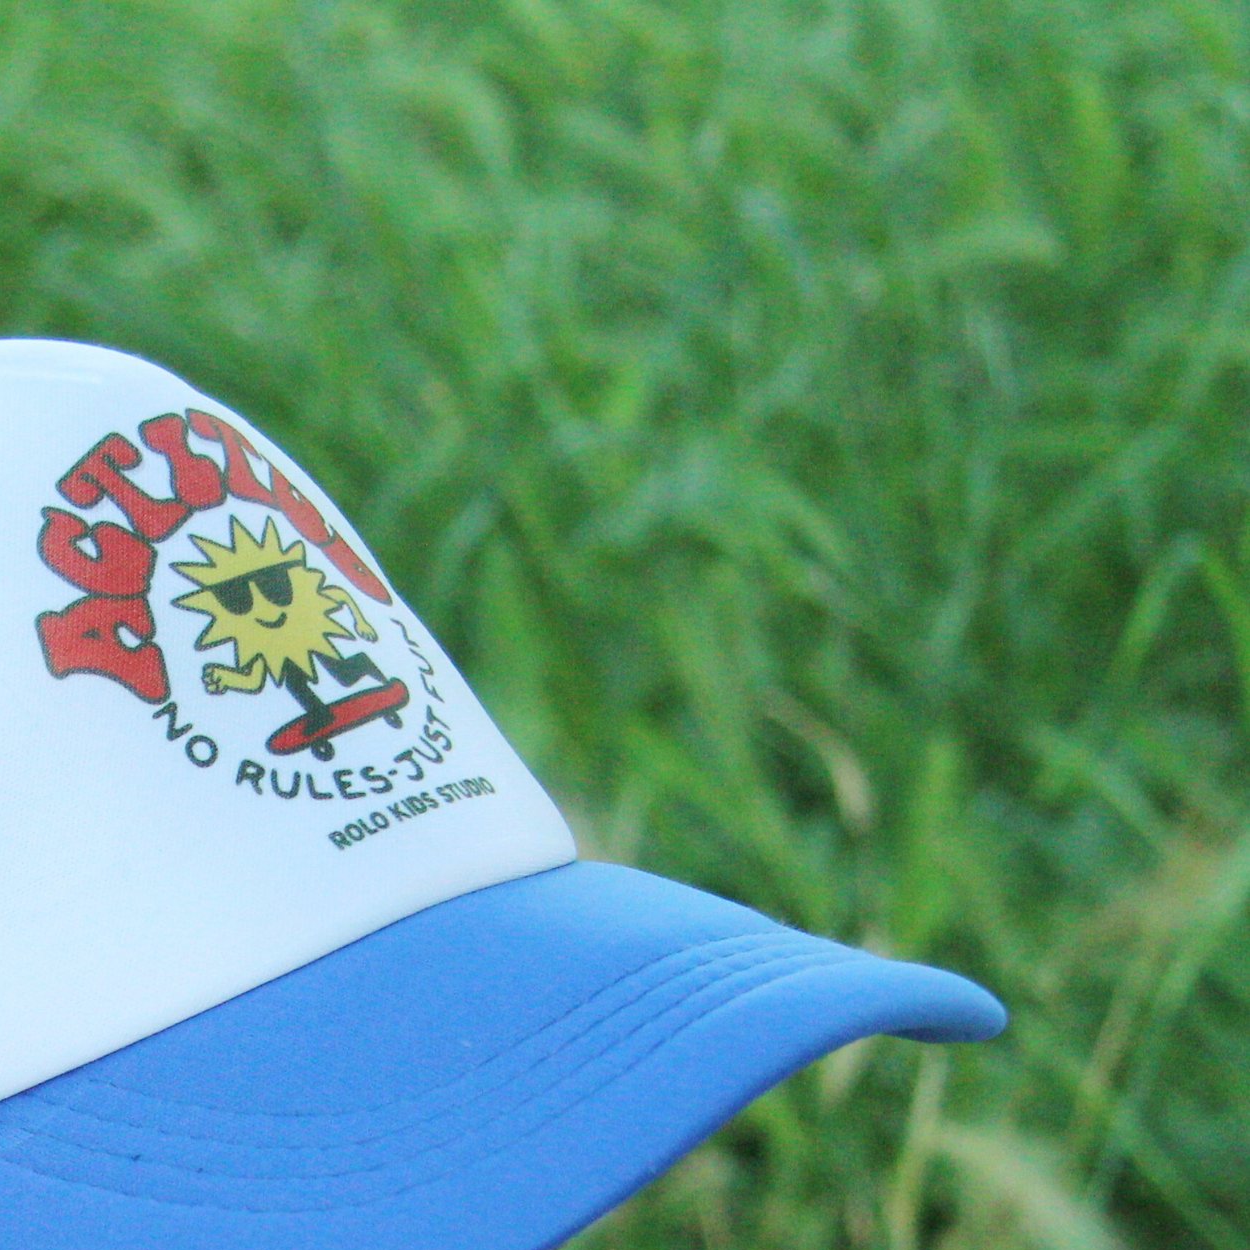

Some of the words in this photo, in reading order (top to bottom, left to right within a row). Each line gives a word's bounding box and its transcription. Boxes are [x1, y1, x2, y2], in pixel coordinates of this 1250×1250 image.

[152, 701, 218, 768] NO
[390, 617, 445, 704] FUN
[328, 811, 390, 850] ROLO
[387, 791, 440, 821] KIDS
[435, 776, 496, 804] STUDIO
